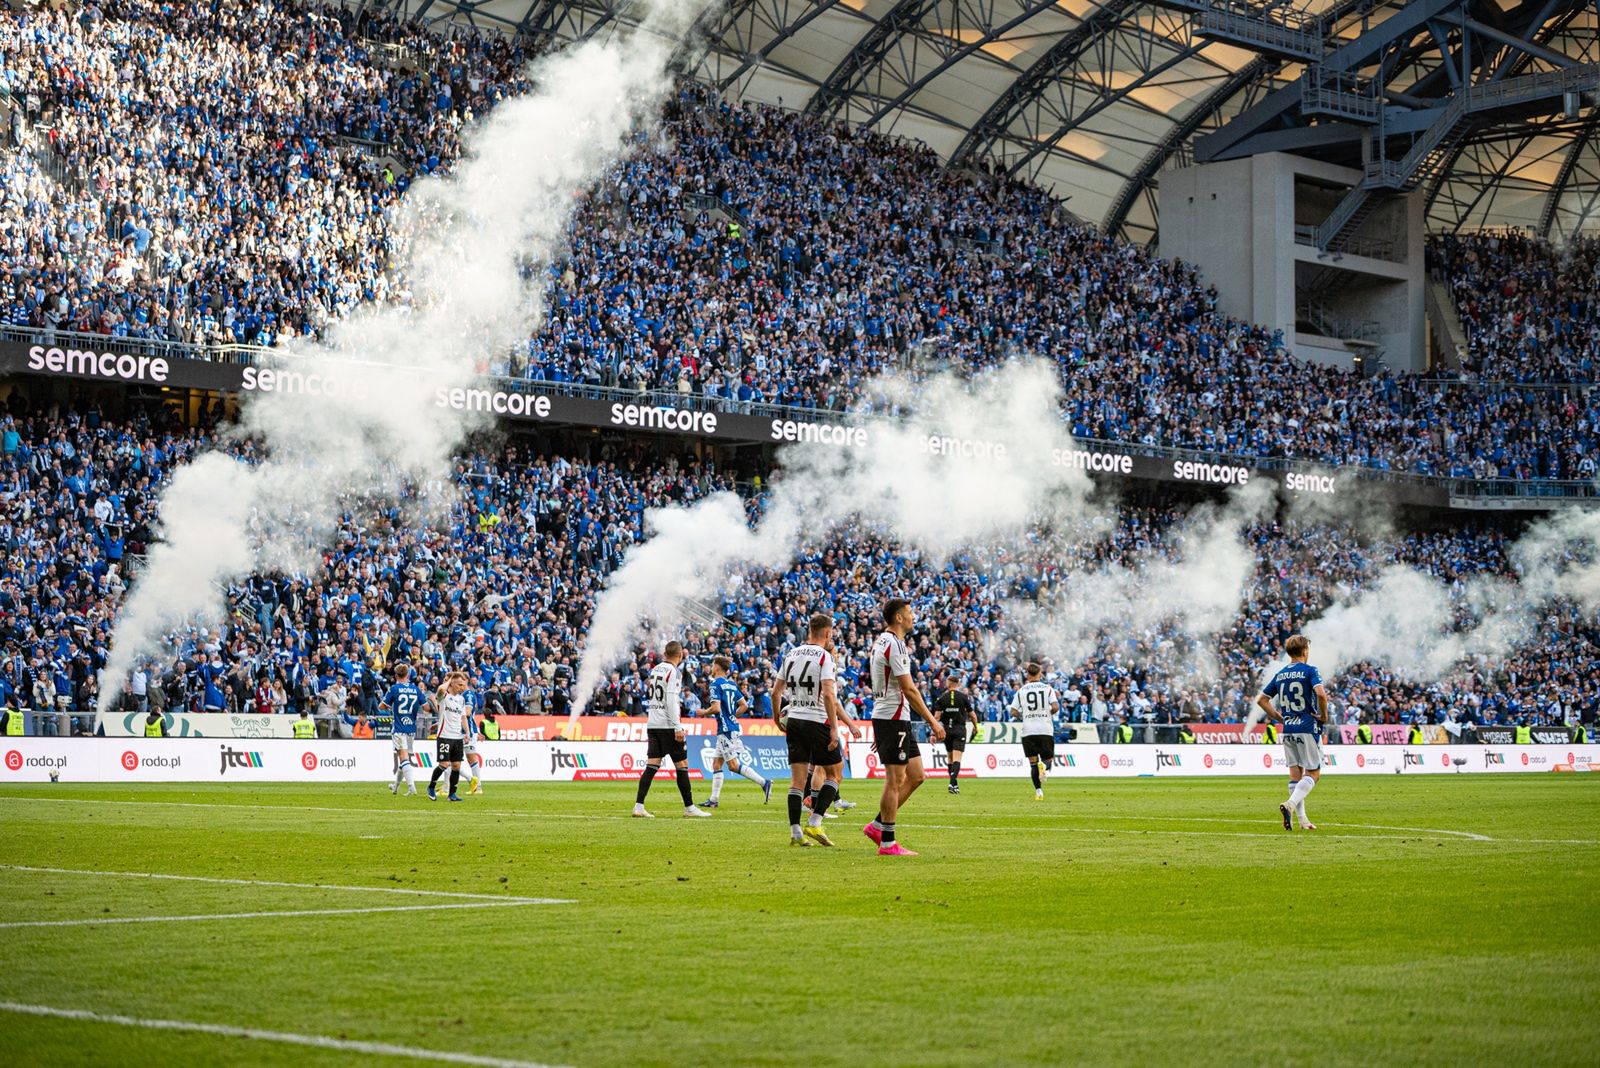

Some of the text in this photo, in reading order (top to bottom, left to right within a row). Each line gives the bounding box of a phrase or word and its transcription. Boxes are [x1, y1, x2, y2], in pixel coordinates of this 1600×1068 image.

[28, 345, 169, 382] semcore
[434, 386, 551, 418] semcore
[611, 402, 718, 434] semcore
[771, 418, 868, 447] semcore
[919, 432, 1007, 460] semcore
[1051, 447, 1134, 474] semcore
[1173, 459, 1249, 486] semcore
[786, 661, 815, 695] 44
[398, 694, 418, 715] 27
[1026, 690, 1045, 711] 91
[1280, 681, 1306, 713] 43
[440, 743, 450, 753] 23
[898, 732, 906, 748] 7
[26, 755, 67, 769] rodo.pl
[141, 755, 181, 769] rodo.pl
[219, 744, 248, 775] jtc
[320, 756, 356, 769] rodo.pl
[485, 757, 518, 769] rodo.pl
[551, 747, 574, 775] jtc
[757, 748, 786, 757] PKO Bank
[998, 757, 1023, 768] rodo.pl
[1111, 757, 1134, 767] rodo.pl
[1214, 757, 1236, 767] rodo.pl
